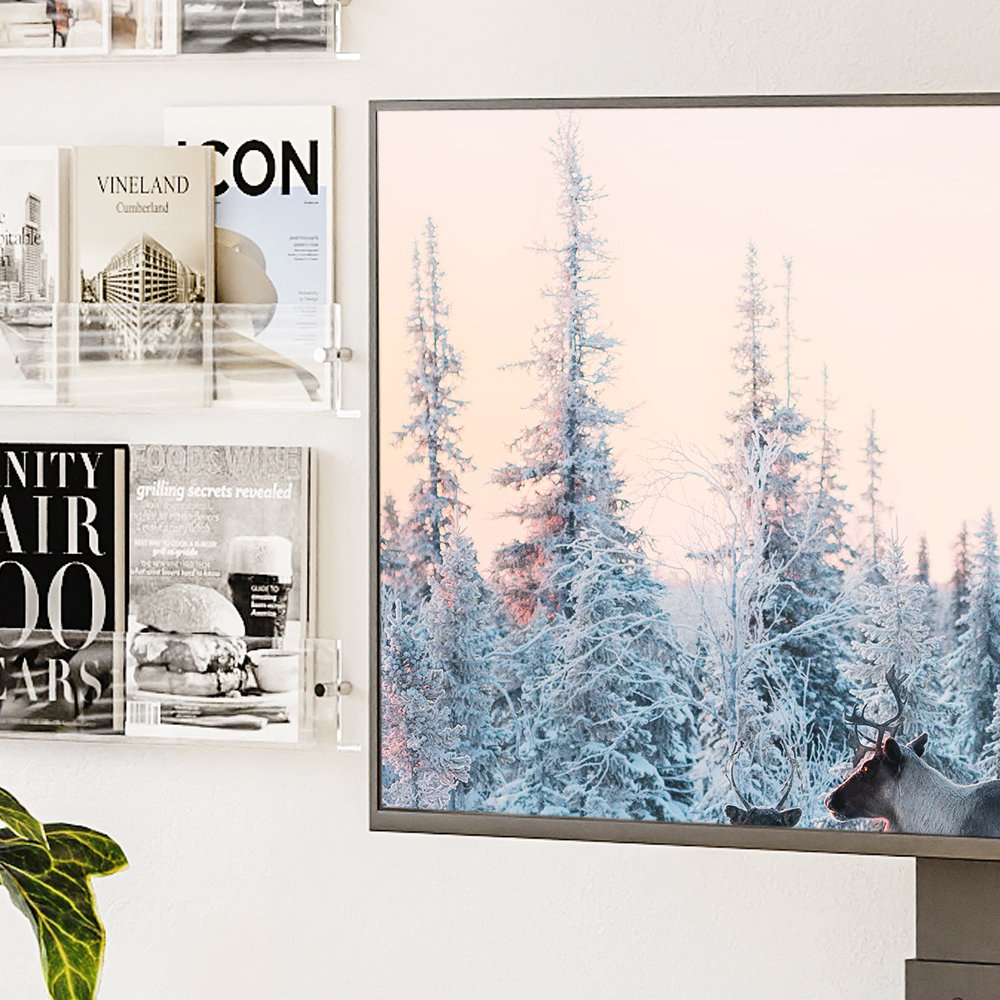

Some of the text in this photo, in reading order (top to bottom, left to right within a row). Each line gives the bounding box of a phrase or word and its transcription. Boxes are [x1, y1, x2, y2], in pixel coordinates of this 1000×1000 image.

[178, 140, 318, 197] CON
[97, 175, 190, 195] VINELAND
[116, 201, 169, 214] Cumberland
[136, 480, 293, 502] grilling secrets revealed
